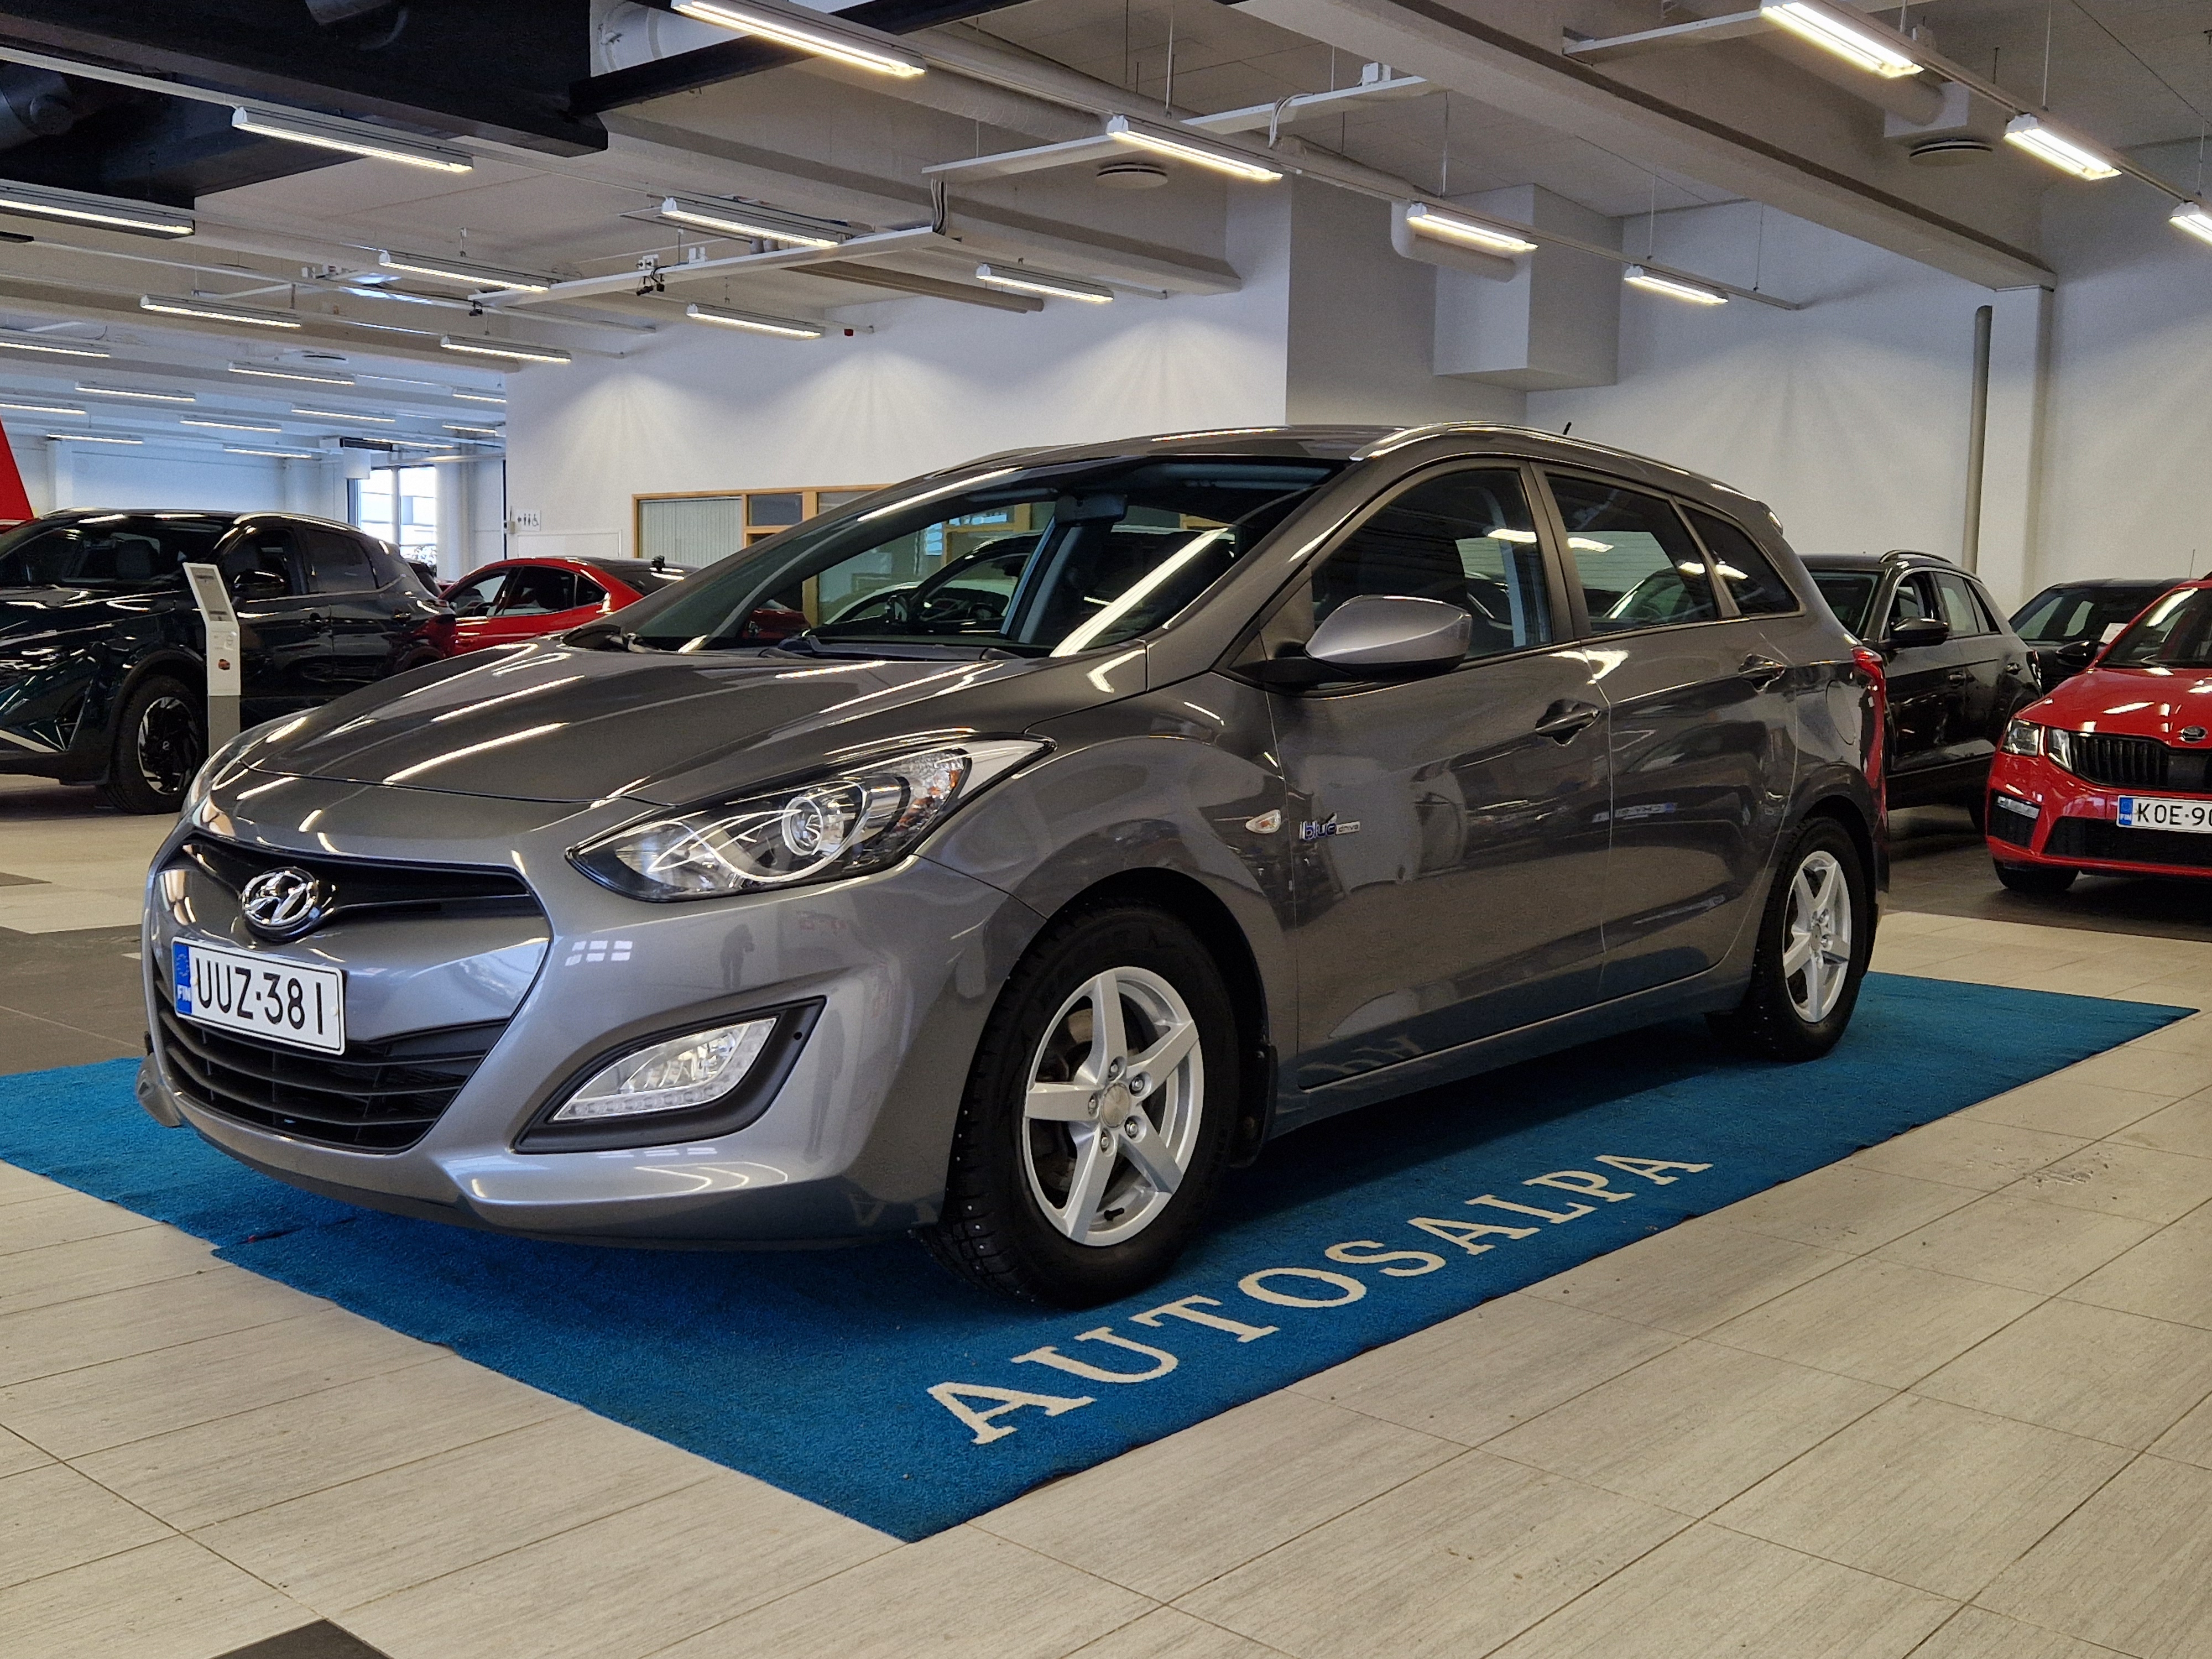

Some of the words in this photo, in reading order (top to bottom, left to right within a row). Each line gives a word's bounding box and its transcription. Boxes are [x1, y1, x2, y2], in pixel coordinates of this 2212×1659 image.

[2137, 803, 2212, 827] KOE-9
[196, 957, 324, 1035] UUZ-381
[927, 1153, 1713, 1444] AUTOSALPA
